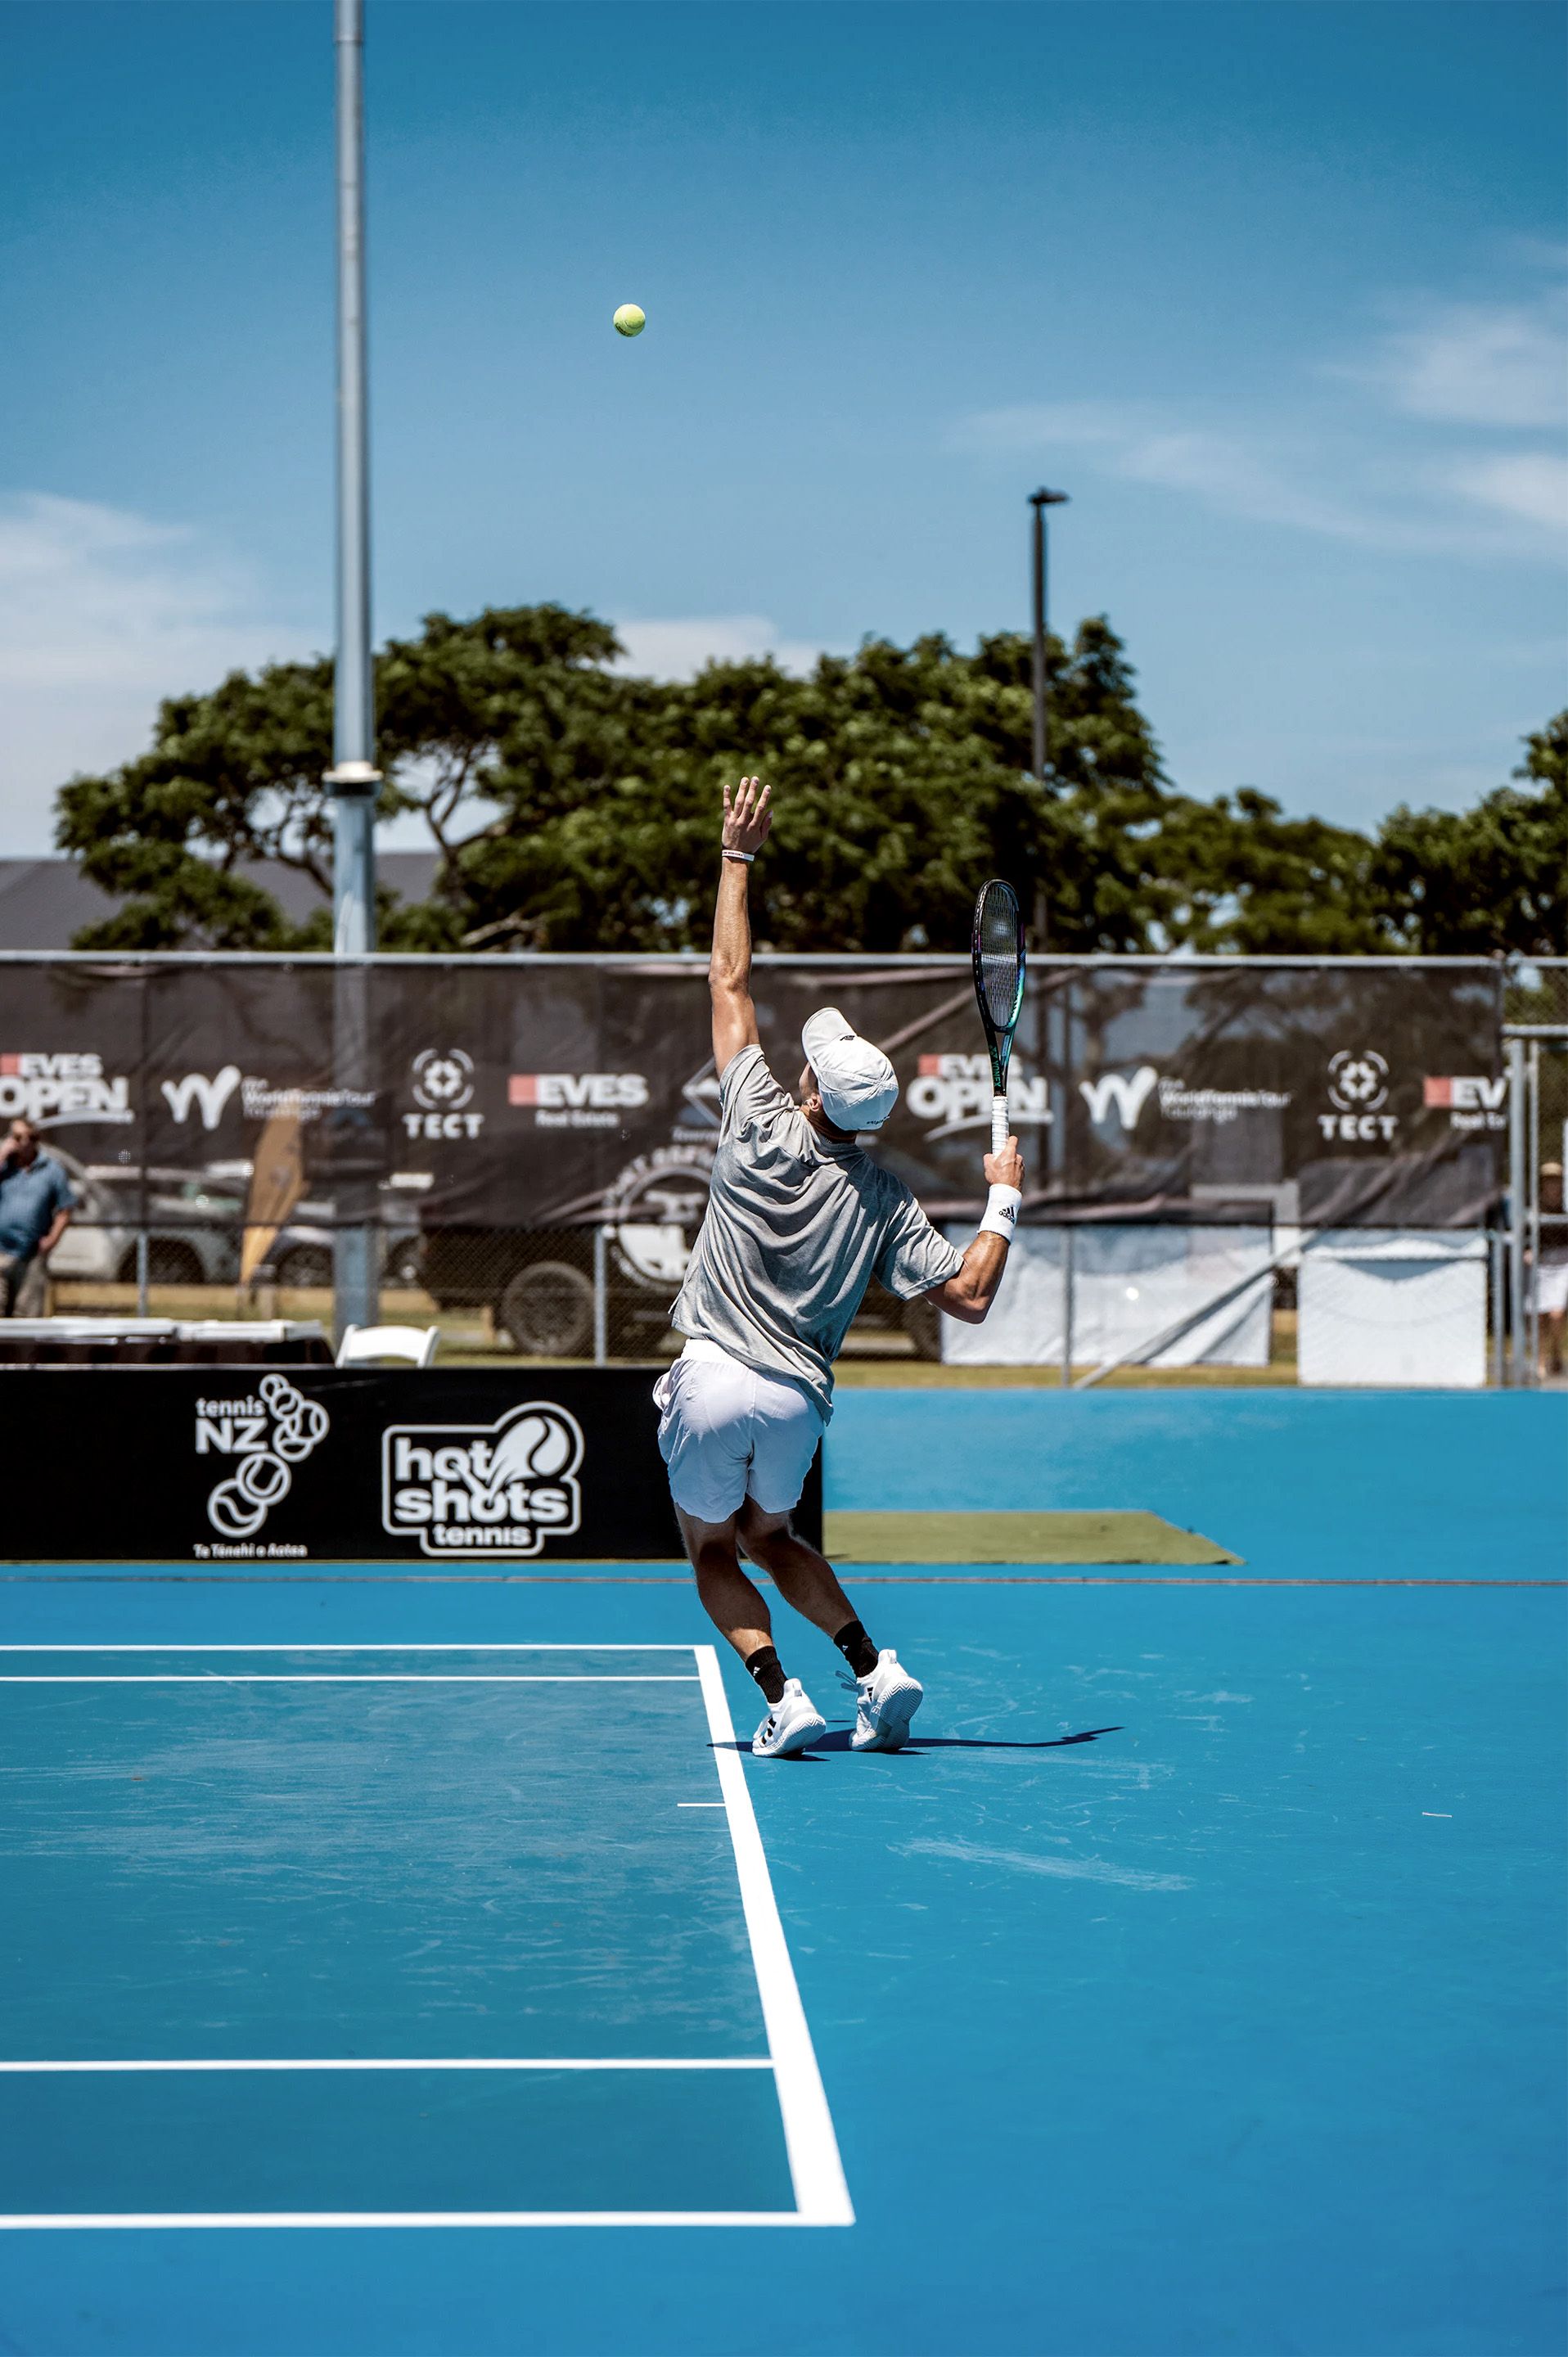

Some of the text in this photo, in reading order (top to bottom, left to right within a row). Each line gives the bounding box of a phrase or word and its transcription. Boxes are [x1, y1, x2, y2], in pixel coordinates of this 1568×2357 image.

[21, 1052, 103, 1076] EVES
[993, 1060, 1002, 1088] YONEX
[0, 1075, 129, 1120] OPEN
[536, 1073, 648, 1107] EVES
[401, 1112, 484, 1139] TECT
[1318, 1114, 1399, 1141] TECT
[196, 1395, 266, 1417] tennis
[196, 1417, 268, 1454] NZ
[394, 1437, 492, 1481] hot
[394, 1479, 570, 1523] shots
[433, 1523, 531, 1546] tennis
[193, 1543, 210, 1558] Te
[255, 1545, 267, 1558] o
